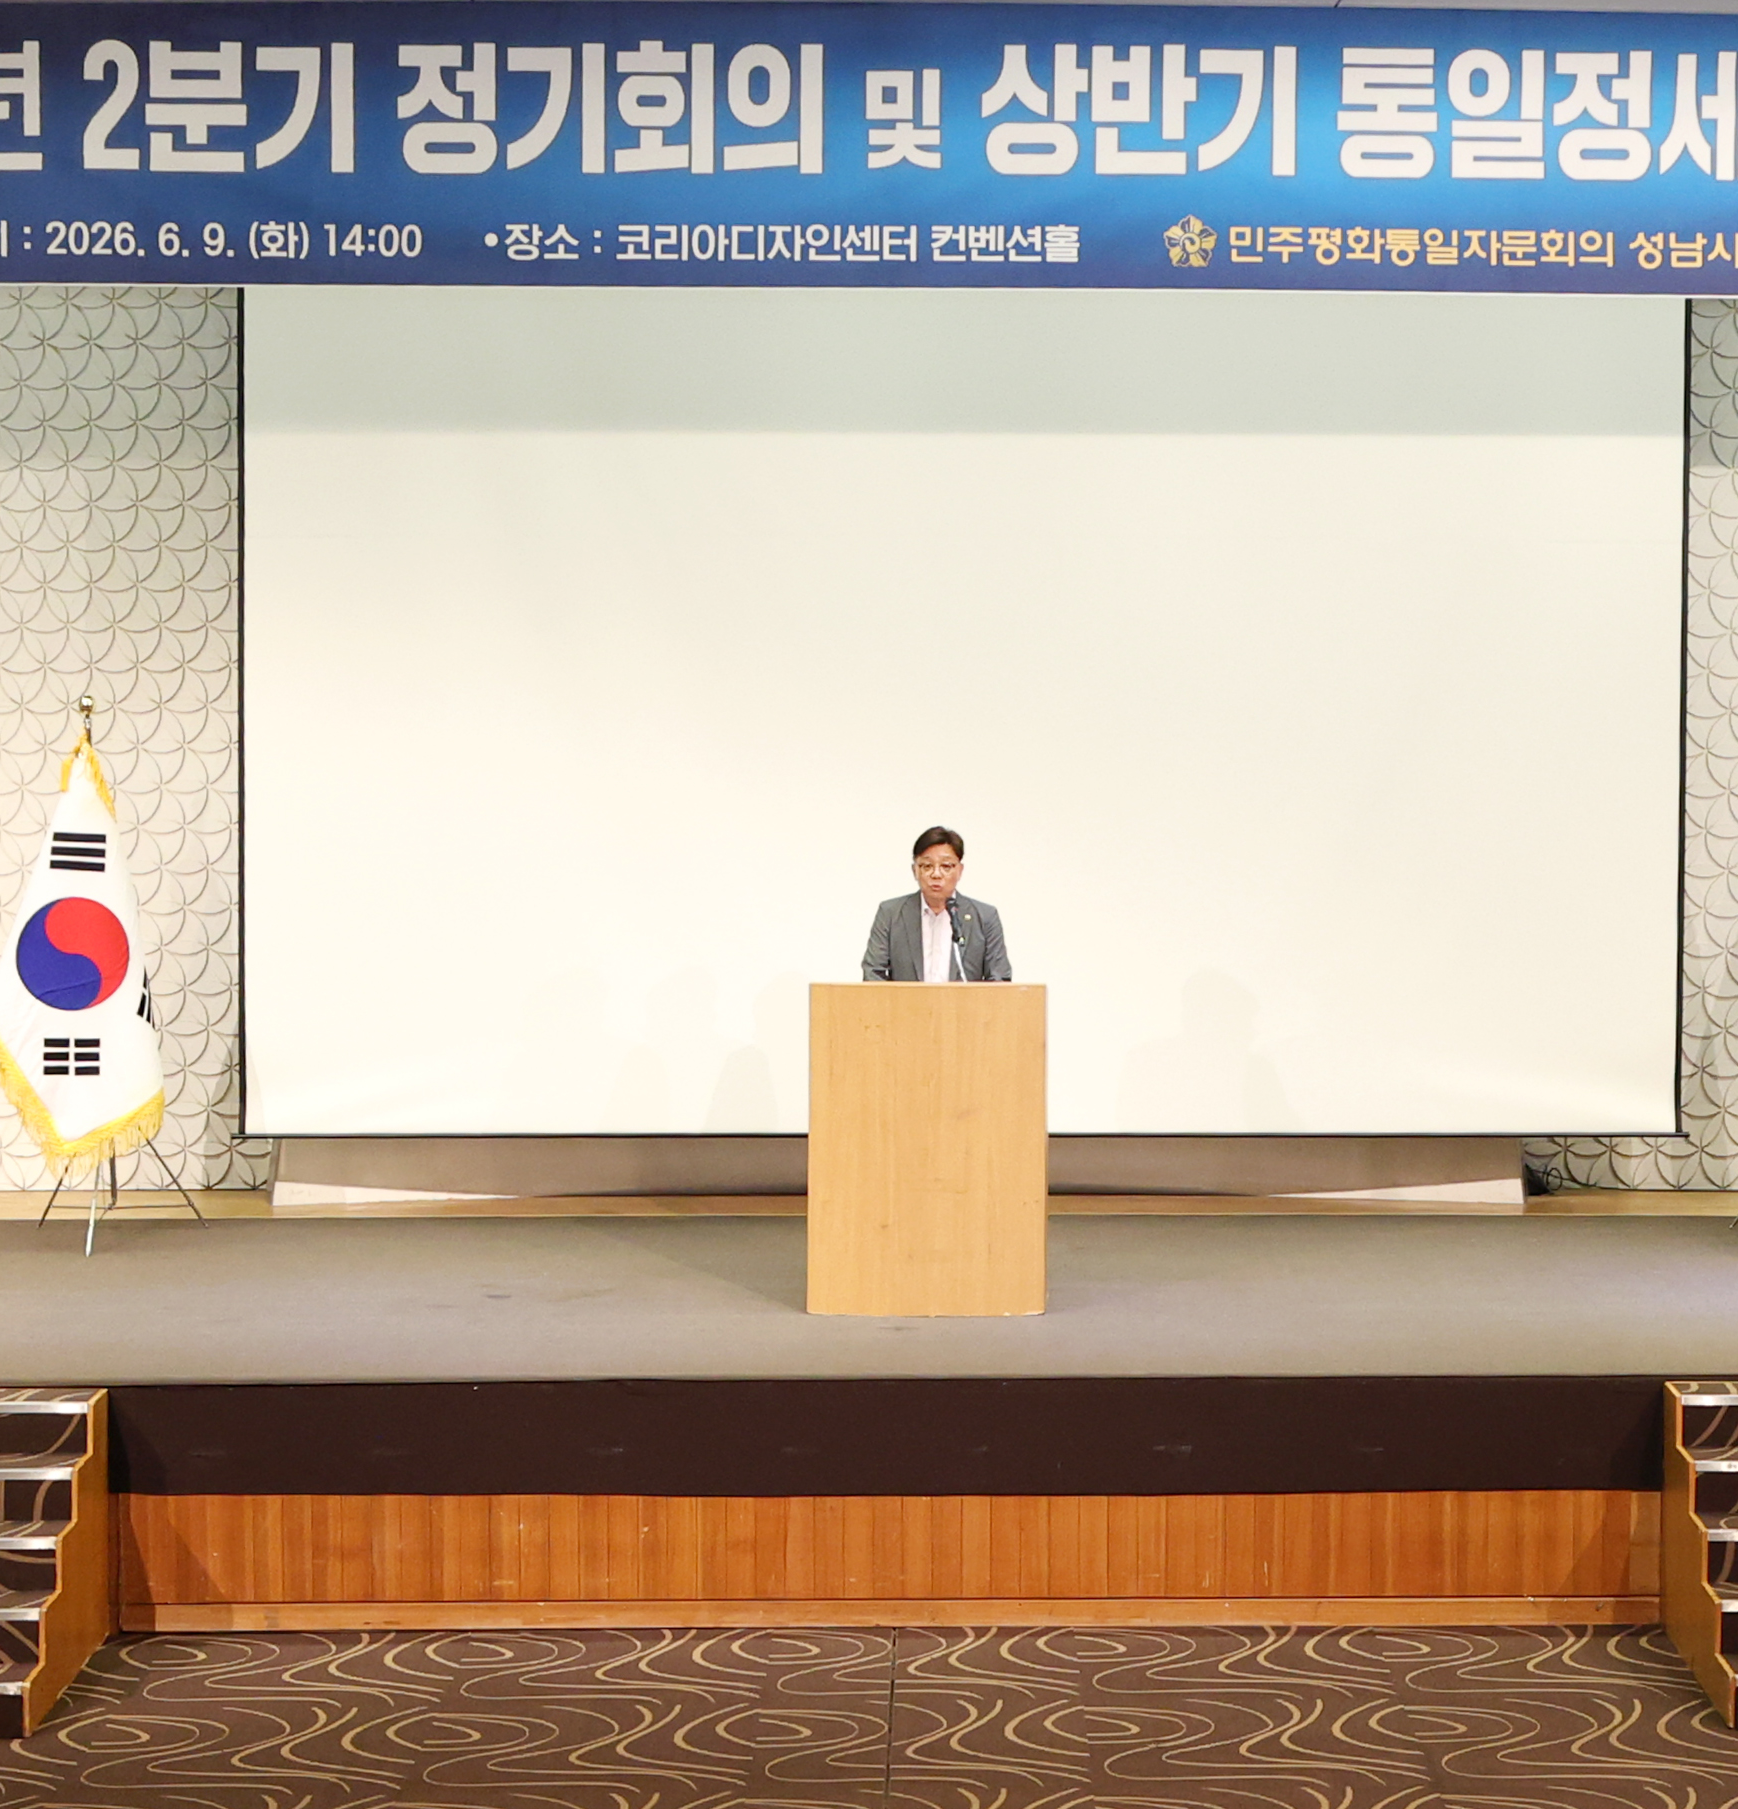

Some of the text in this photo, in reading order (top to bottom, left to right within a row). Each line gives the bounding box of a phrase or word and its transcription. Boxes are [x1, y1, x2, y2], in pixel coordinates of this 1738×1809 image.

[83, 40, 354, 173] 2분기
[397, 40, 824, 175] 정기회의
[865, 68, 942, 169] 및
[981, 43, 1297, 177] 상반기
[45, 221, 145, 257] 2026.
[158, 222, 190, 257] 6.
[203, 222, 235, 257] 9.
[249, 220, 309, 260] (화)
[323, 224, 422, 258] 14:00
[504, 223, 579, 261] 장소
[616, 223, 918, 262] 코리아디자인센터
[930, 223, 1081, 263] 컨벤션홀
[1229, 225, 1614, 268] 민주평화통일자문회의
